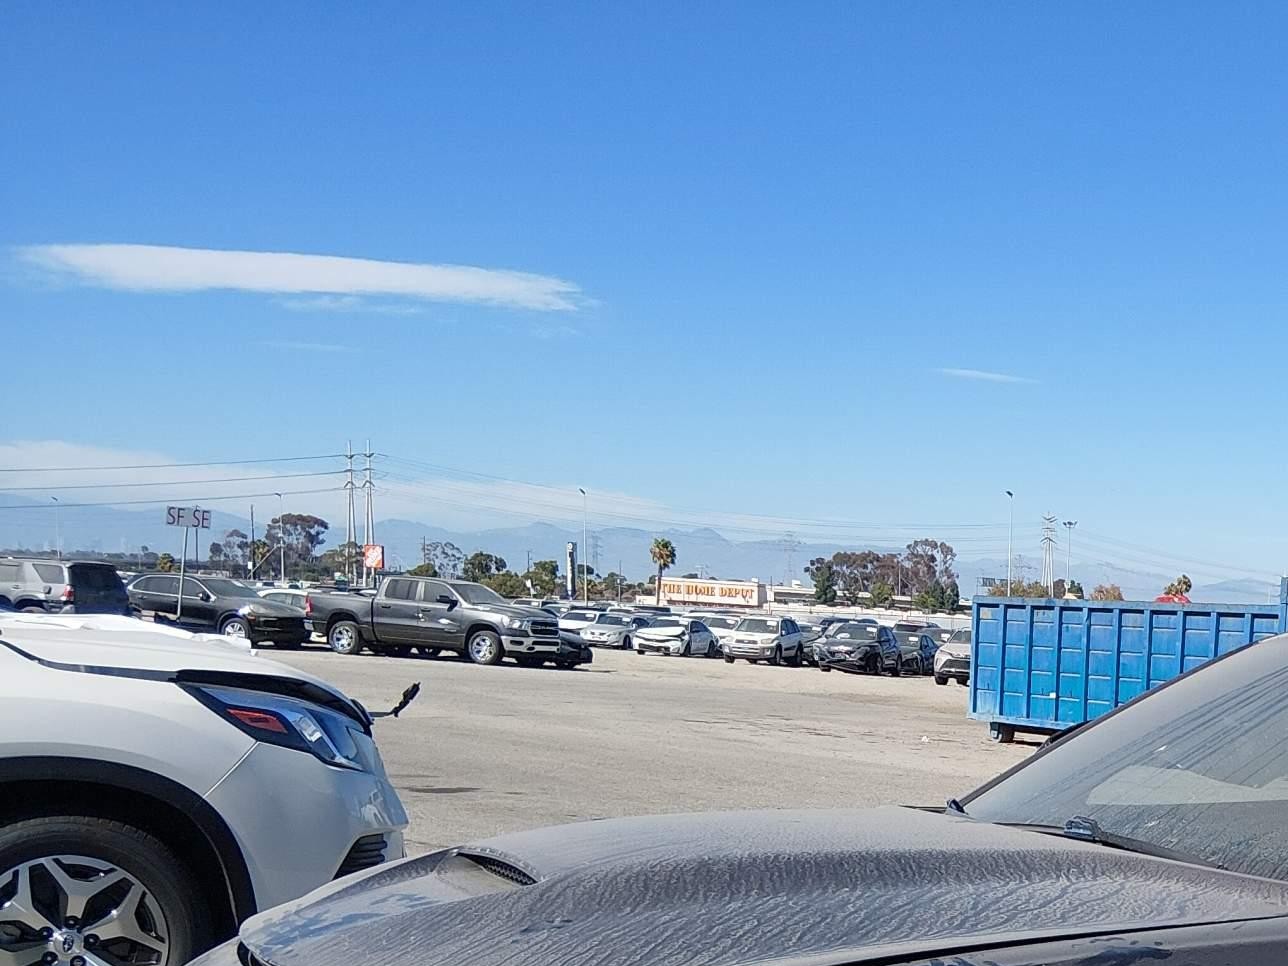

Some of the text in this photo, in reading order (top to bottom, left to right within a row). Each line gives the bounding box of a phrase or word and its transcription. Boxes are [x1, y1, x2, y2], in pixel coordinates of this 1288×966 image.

[167, 506, 185, 526] SF
[192, 509, 210, 529] SE
[662, 583, 755, 599] THE HOME DEPOT
